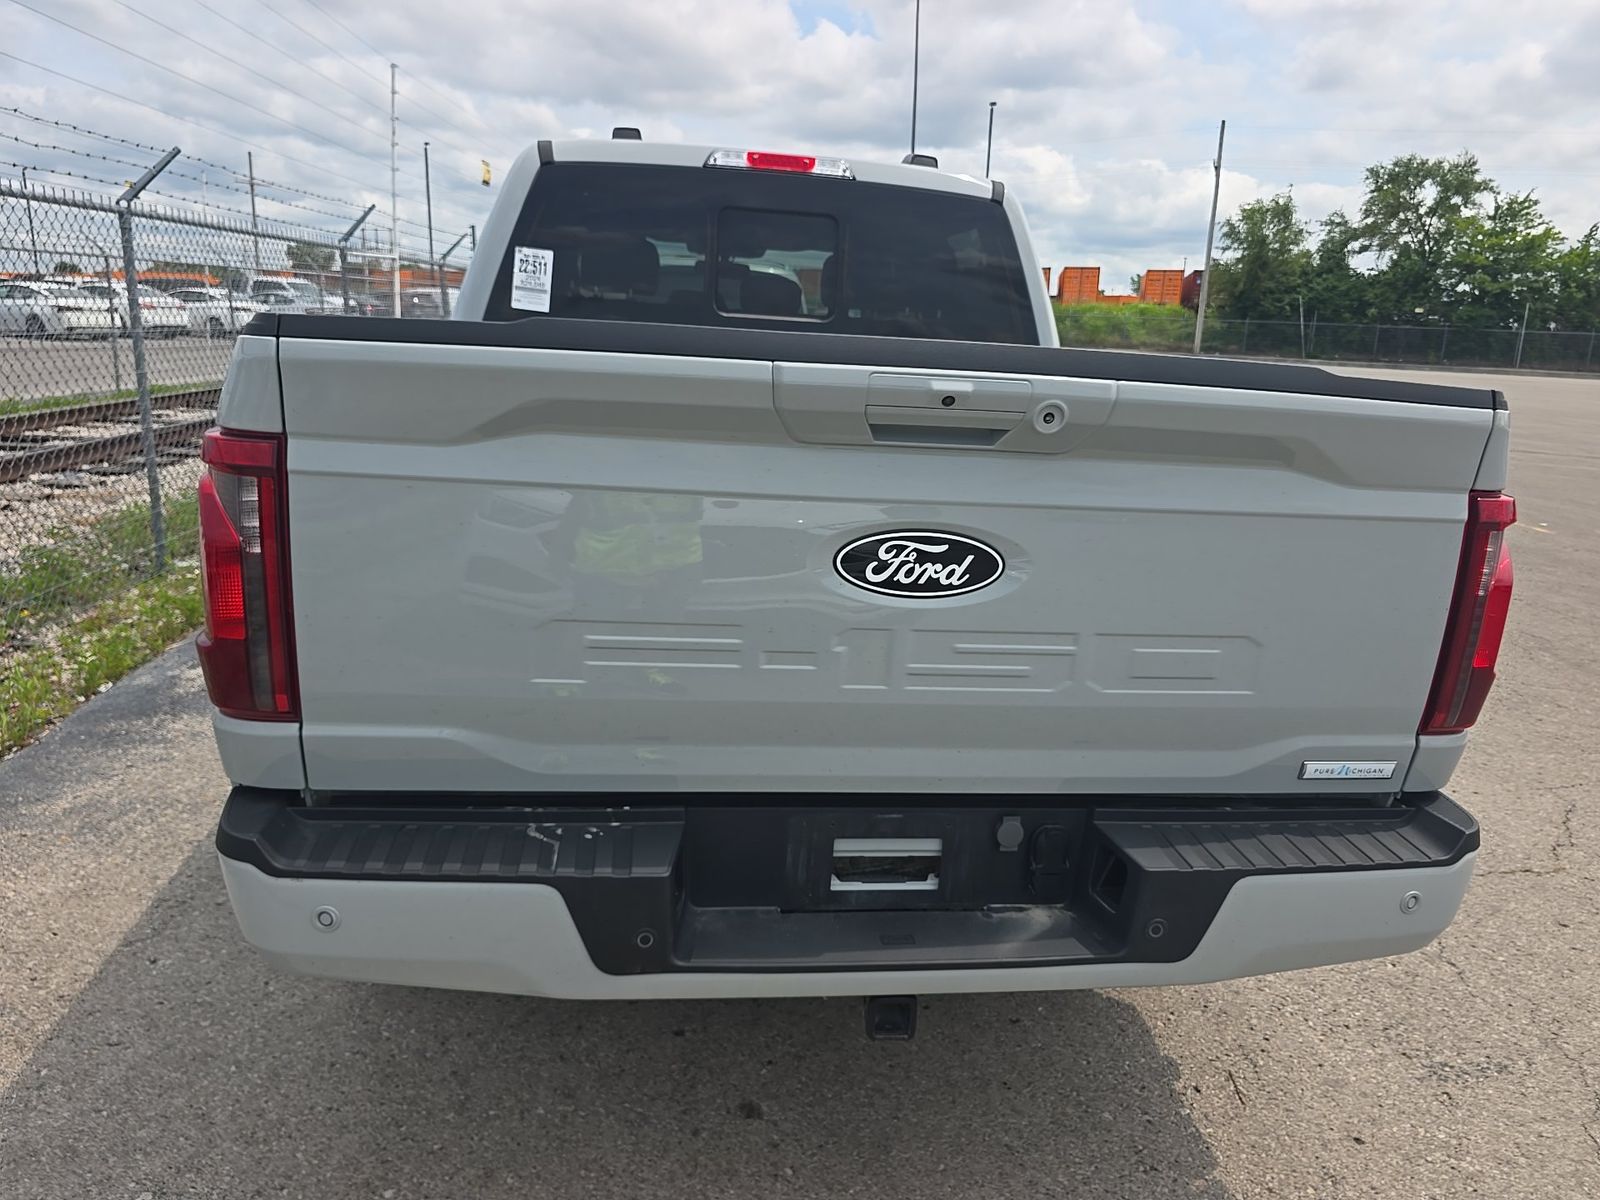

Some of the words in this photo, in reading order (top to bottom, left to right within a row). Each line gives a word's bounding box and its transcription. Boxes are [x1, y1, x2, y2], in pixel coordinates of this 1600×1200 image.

[865, 540, 975, 586] Ford
[529, 618, 1264, 695] F-150
[1313, 767, 1335, 775] PURE
[1336, 764, 1385, 776] MICHIGAN
